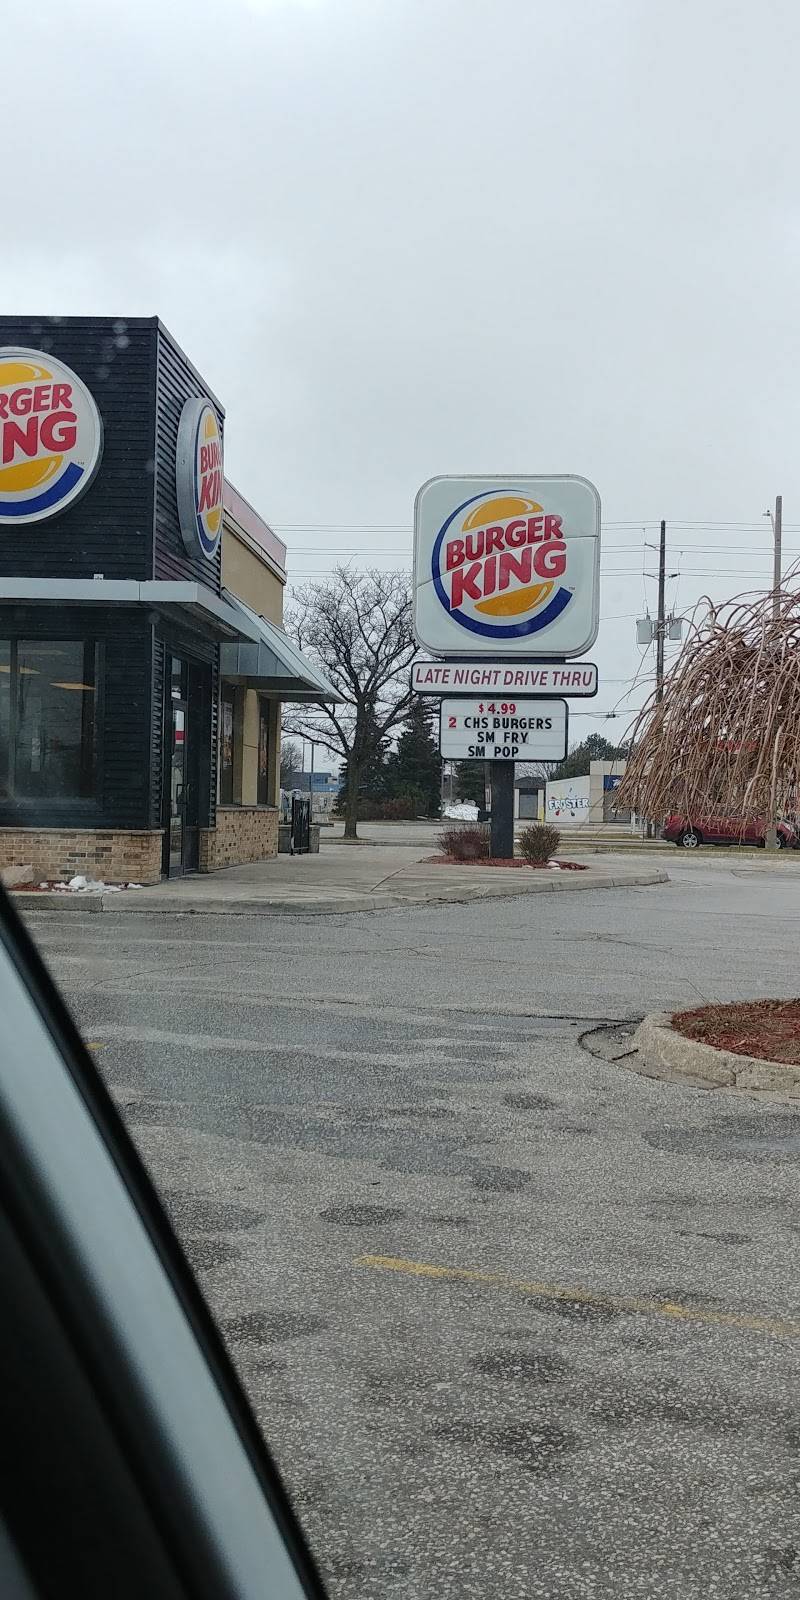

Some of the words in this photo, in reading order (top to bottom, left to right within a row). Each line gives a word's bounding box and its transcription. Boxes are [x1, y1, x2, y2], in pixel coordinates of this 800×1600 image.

[446, 514, 563, 571] BURGER
[450, 540, 567, 611] KING
[415, 668, 451, 684] LATE
[453, 669, 501, 685] NIGHT
[503, 670, 549, 686] DRIVE
[552, 671, 593, 687] THRU
[448, 716, 457, 728] 2
[463, 717, 489, 729] CHS
[493, 717, 552, 729] BURGERS
[477, 731, 495, 743] SM
[503, 732, 529, 744] FRY
[468, 745, 486, 757] SM
[494, 746, 519, 758] POP
[548, 797, 590, 810] FROSTER
